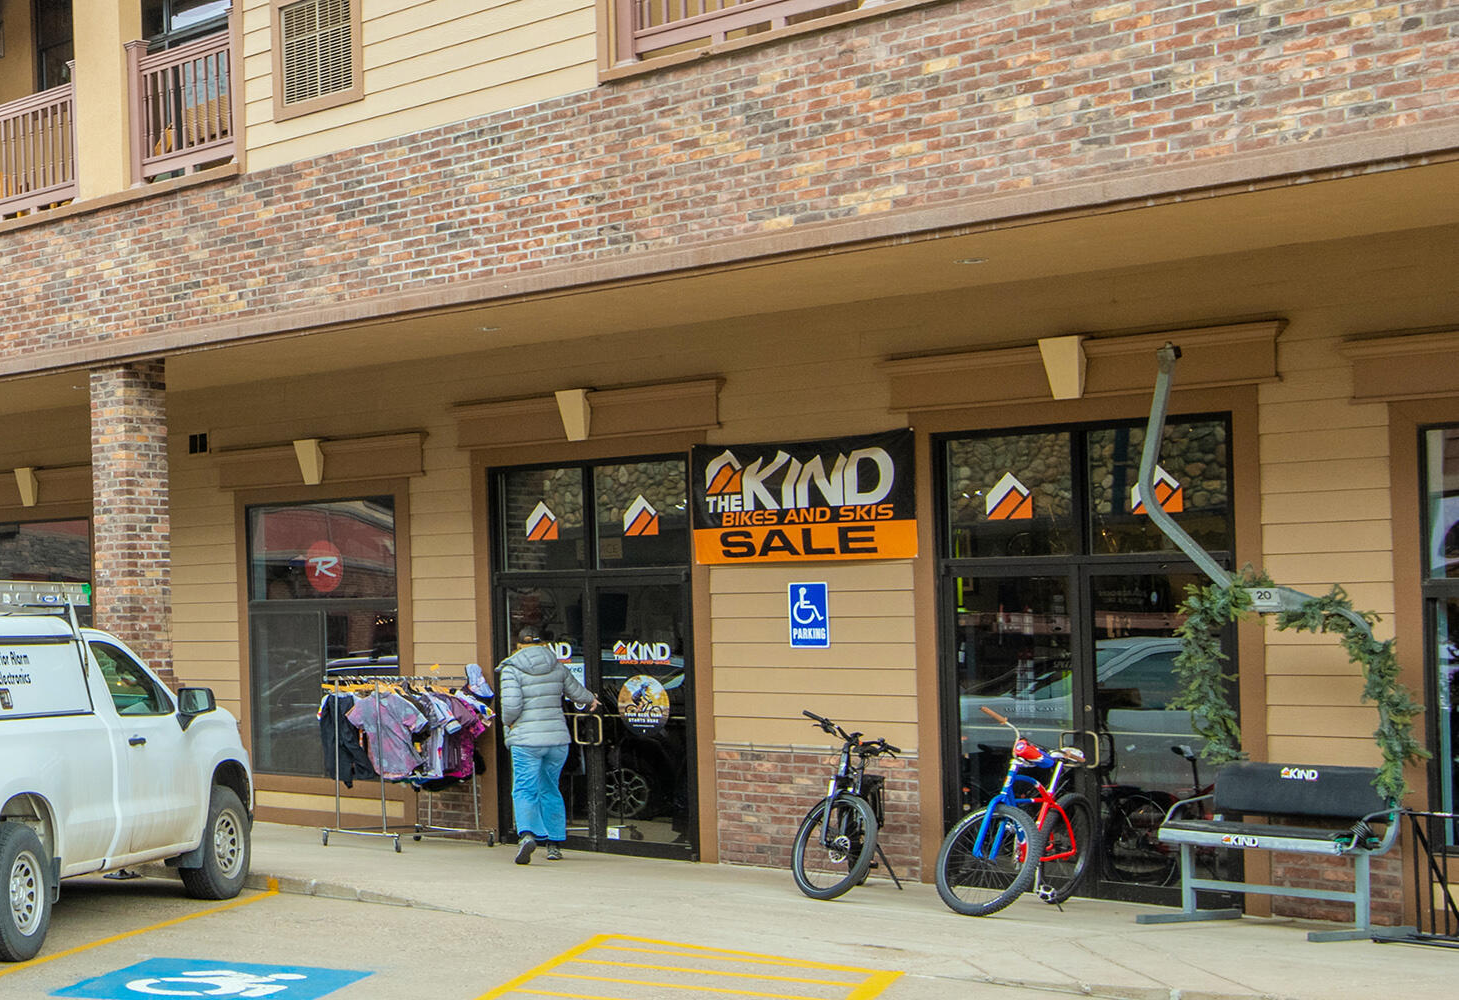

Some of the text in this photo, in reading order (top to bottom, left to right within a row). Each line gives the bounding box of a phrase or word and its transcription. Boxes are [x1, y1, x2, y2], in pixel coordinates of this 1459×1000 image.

[706, 446, 895, 513] THE KIND
[722, 503, 894, 527] BIKES AND SKIS
[720, 525, 878, 558] SALE
[309, 556, 338, 577] R
[1256, 590, 1272, 600] 20
[793, 627, 826, 640] PARKING
[10, 651, 30, 665] Alarm
[626, 640, 671, 661] KIND
[1289, 767, 1318, 780] KIND
[1230, 834, 1259, 848] KIND
